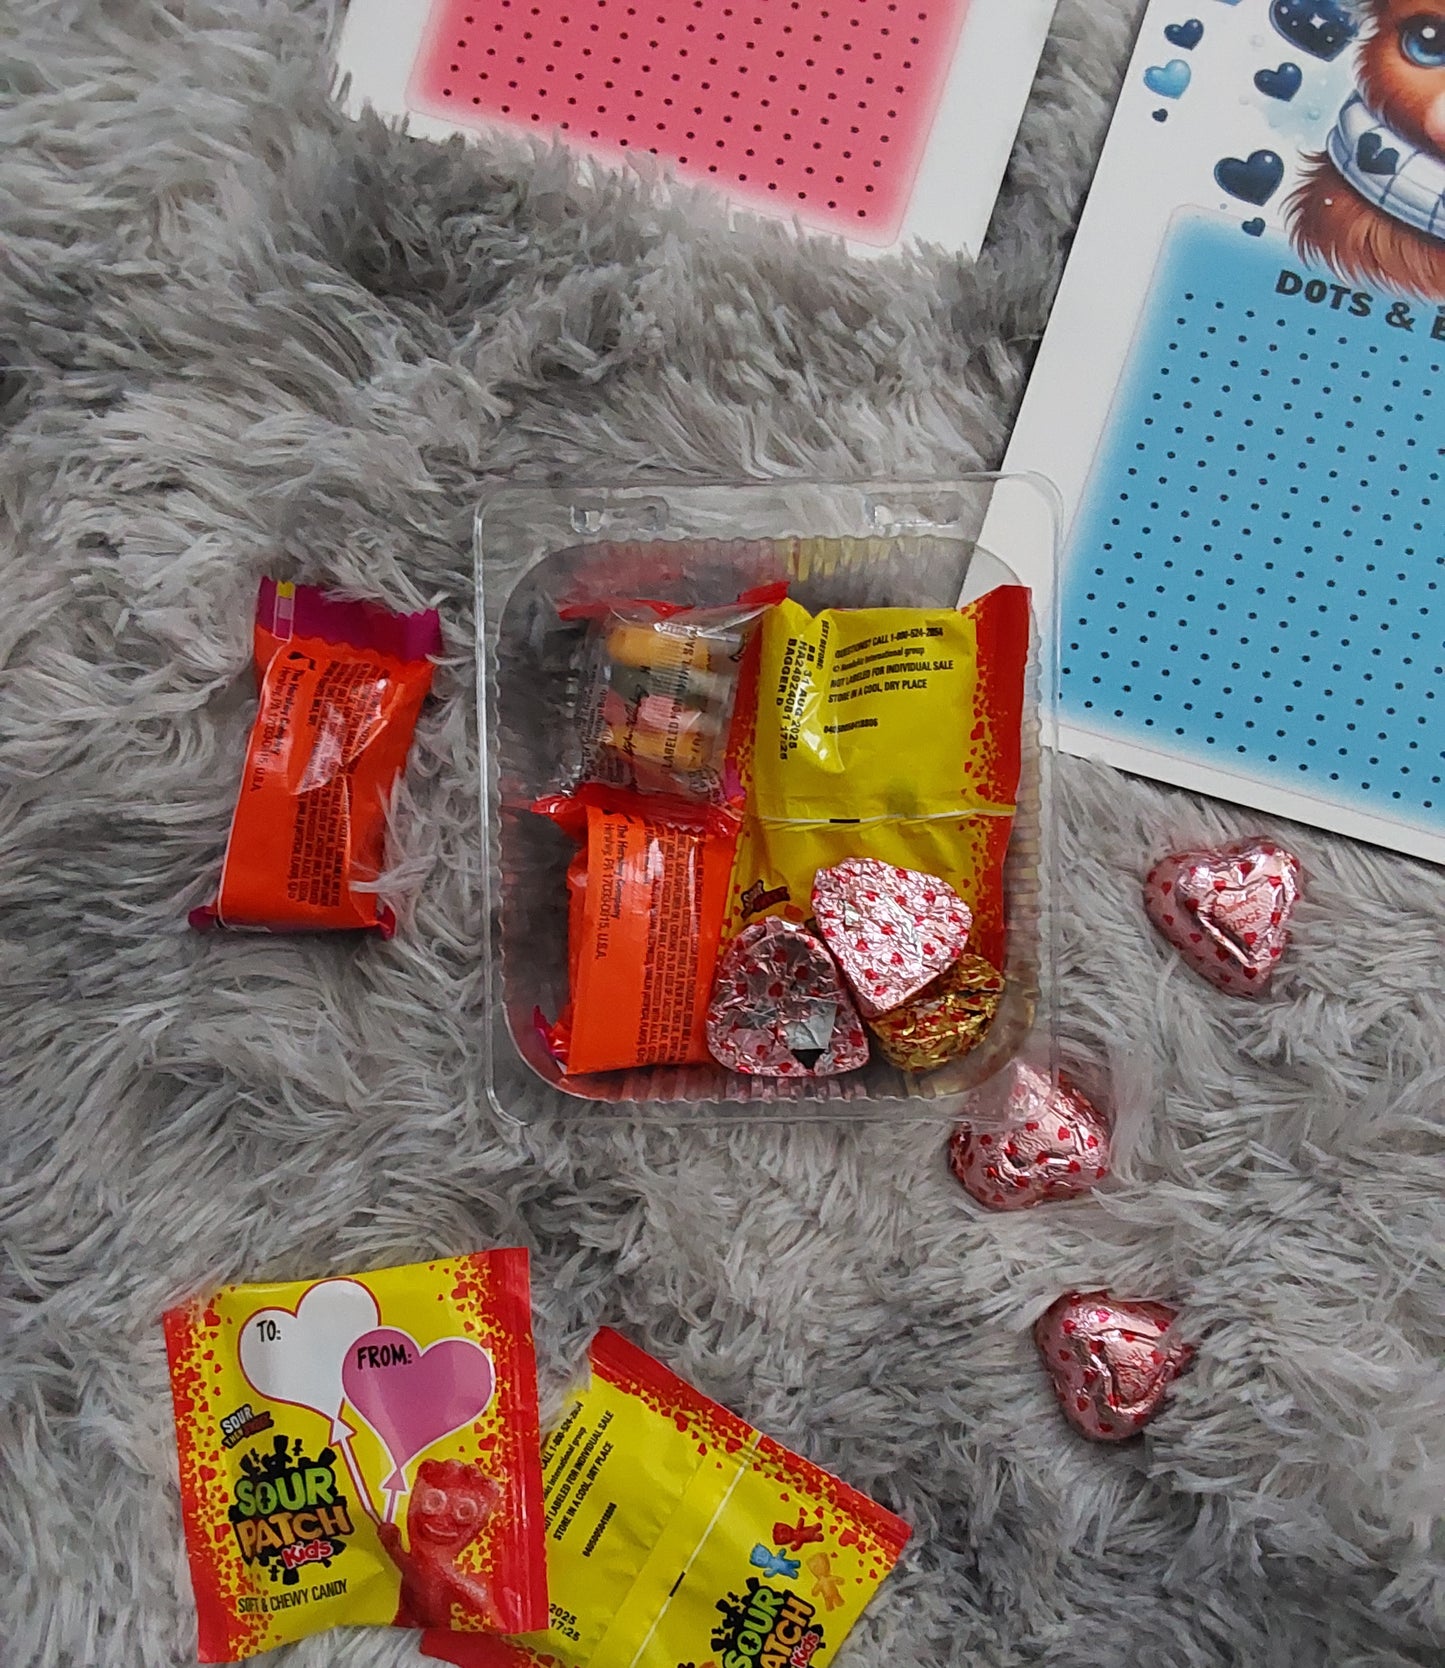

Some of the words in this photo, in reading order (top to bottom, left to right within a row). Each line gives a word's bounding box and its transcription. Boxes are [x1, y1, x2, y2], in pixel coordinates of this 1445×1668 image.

[1275, 269, 1374, 317] DOTS
[1385, 301, 1416, 333] &
[872, 633, 890, 649] CALL
[778, 638, 797, 694] BAGGER
[803, 669, 813, 684] 31
[871, 665, 886, 678] FOR
[886, 660, 932, 676] INDIVIDUAL
[932, 660, 954, 671] SALE
[884, 680, 900, 692] DRY
[901, 677, 928, 690] PLACE
[269, 698, 281, 710] PA
[776, 697, 784, 706] D
[796, 688, 808, 716] AUG
[603, 858, 613, 870] PA
[257, 1320, 282, 1342] TO:
[357, 1344, 412, 1369] FROM:
[222, 1406, 253, 1434] SOUR
[541, 1451, 555, 1470] CALL
[548, 1443, 575, 1487] International
[572, 1426, 588, 1447] group
[550, 1483, 571, 1517] LABELED
[566, 1468, 579, 1485] FOR
[575, 1430, 603, 1472] INDIVIDUAL
[598, 1410, 614, 1431] SALE
[595, 1441, 614, 1467] PLACE
[586, 1462, 601, 1481] DRY
[236, 1467, 334, 1517] SOUR
[575, 1478, 593, 1502] COOL,
[567, 1504, 577, 1518] IN
[572, 1498, 581, 1509] A
[236, 1505, 351, 1558] PATCH
[553, 1515, 572, 1541] STORE
[282, 1539, 334, 1570] Kids
[238, 1595, 260, 1614] SOFT
[261, 1597, 269, 1612] &
[270, 1586, 310, 1612] CHEWY
[311, 1578, 348, 1602] CANDY
[549, 1603, 577, 1625] 2025
[550, 1618, 581, 1642] 17:25
[725, 1588, 785, 1668] SOUR
[760, 1597, 815, 1668] ATCH
[790, 1631, 820, 1668] Kids
